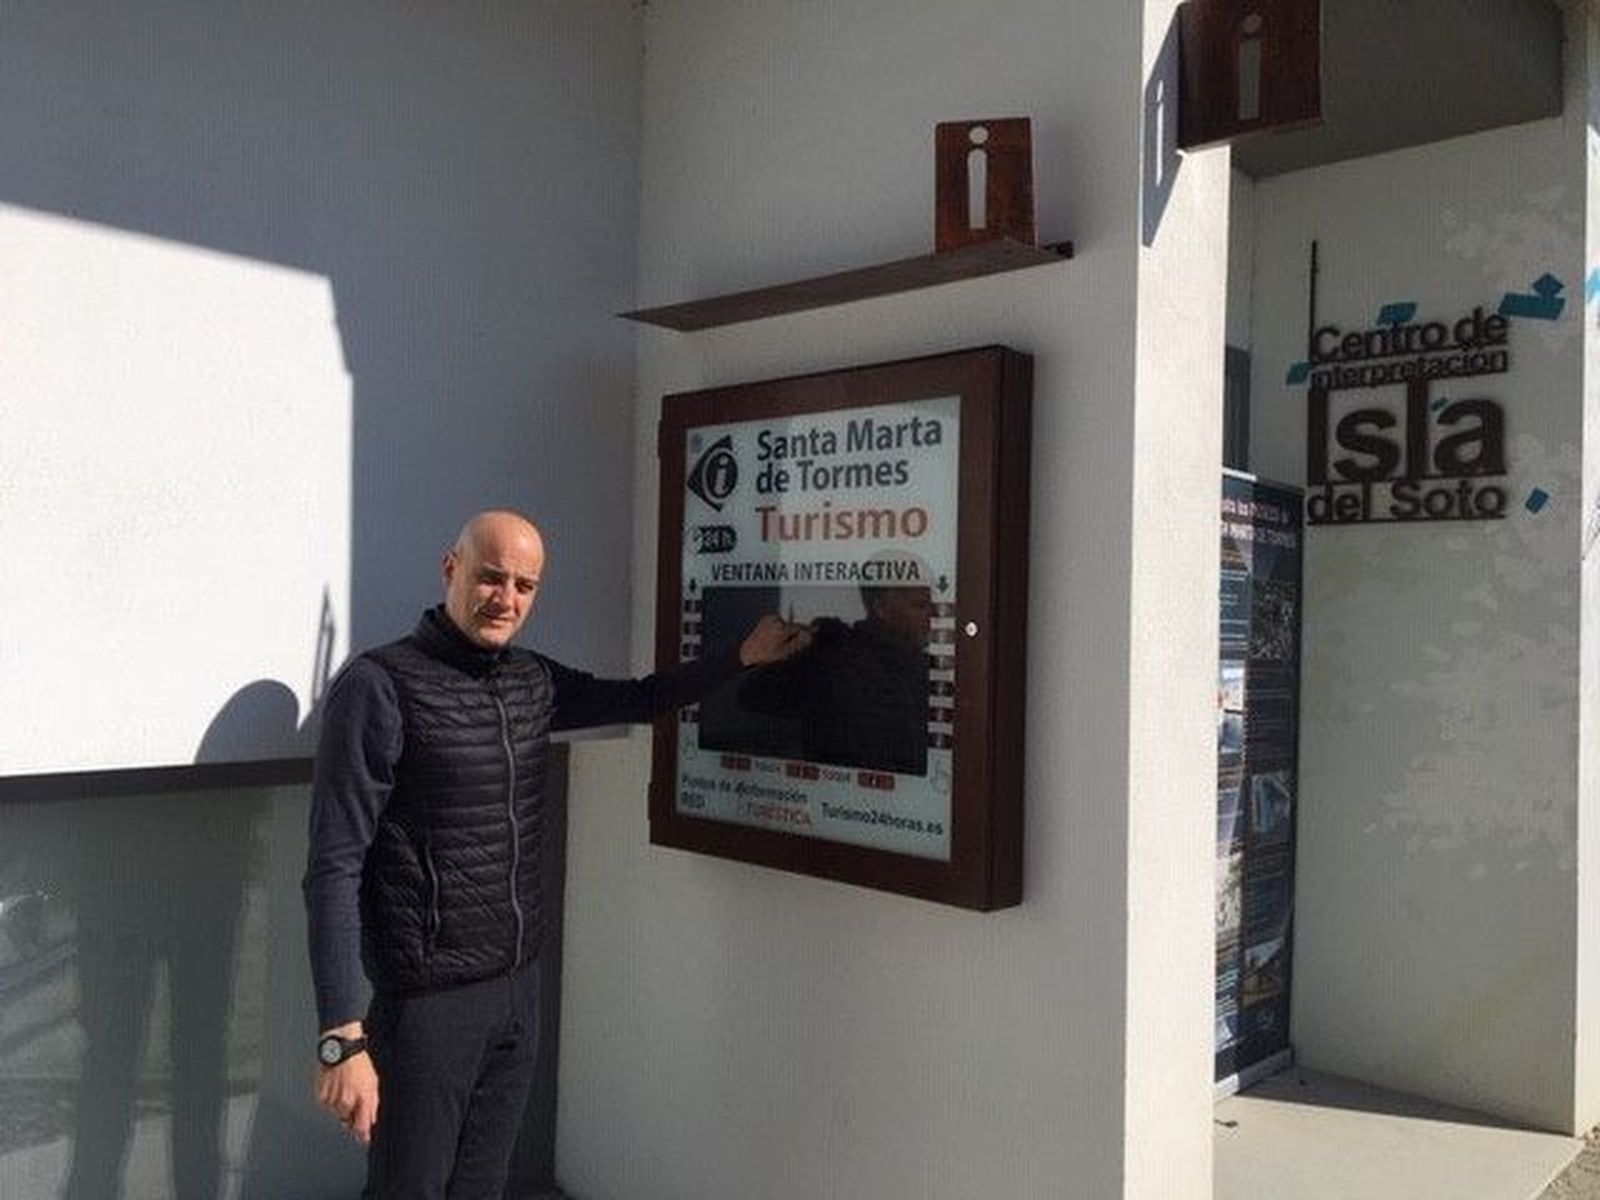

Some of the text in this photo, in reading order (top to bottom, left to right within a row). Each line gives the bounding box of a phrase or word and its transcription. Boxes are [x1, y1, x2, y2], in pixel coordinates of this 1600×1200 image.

[1312, 305, 1509, 362] Centro de
[757, 415, 942, 461] Santa Marta
[1307, 377, 1507, 485] Isla
[756, 458, 908, 493] de Tormes
[756, 502, 928, 541] Turismo
[1307, 480, 1372, 523] del
[1389, 476, 1507, 519] Soto
[711, 560, 920, 582] VENTANA INTERACTIVA
